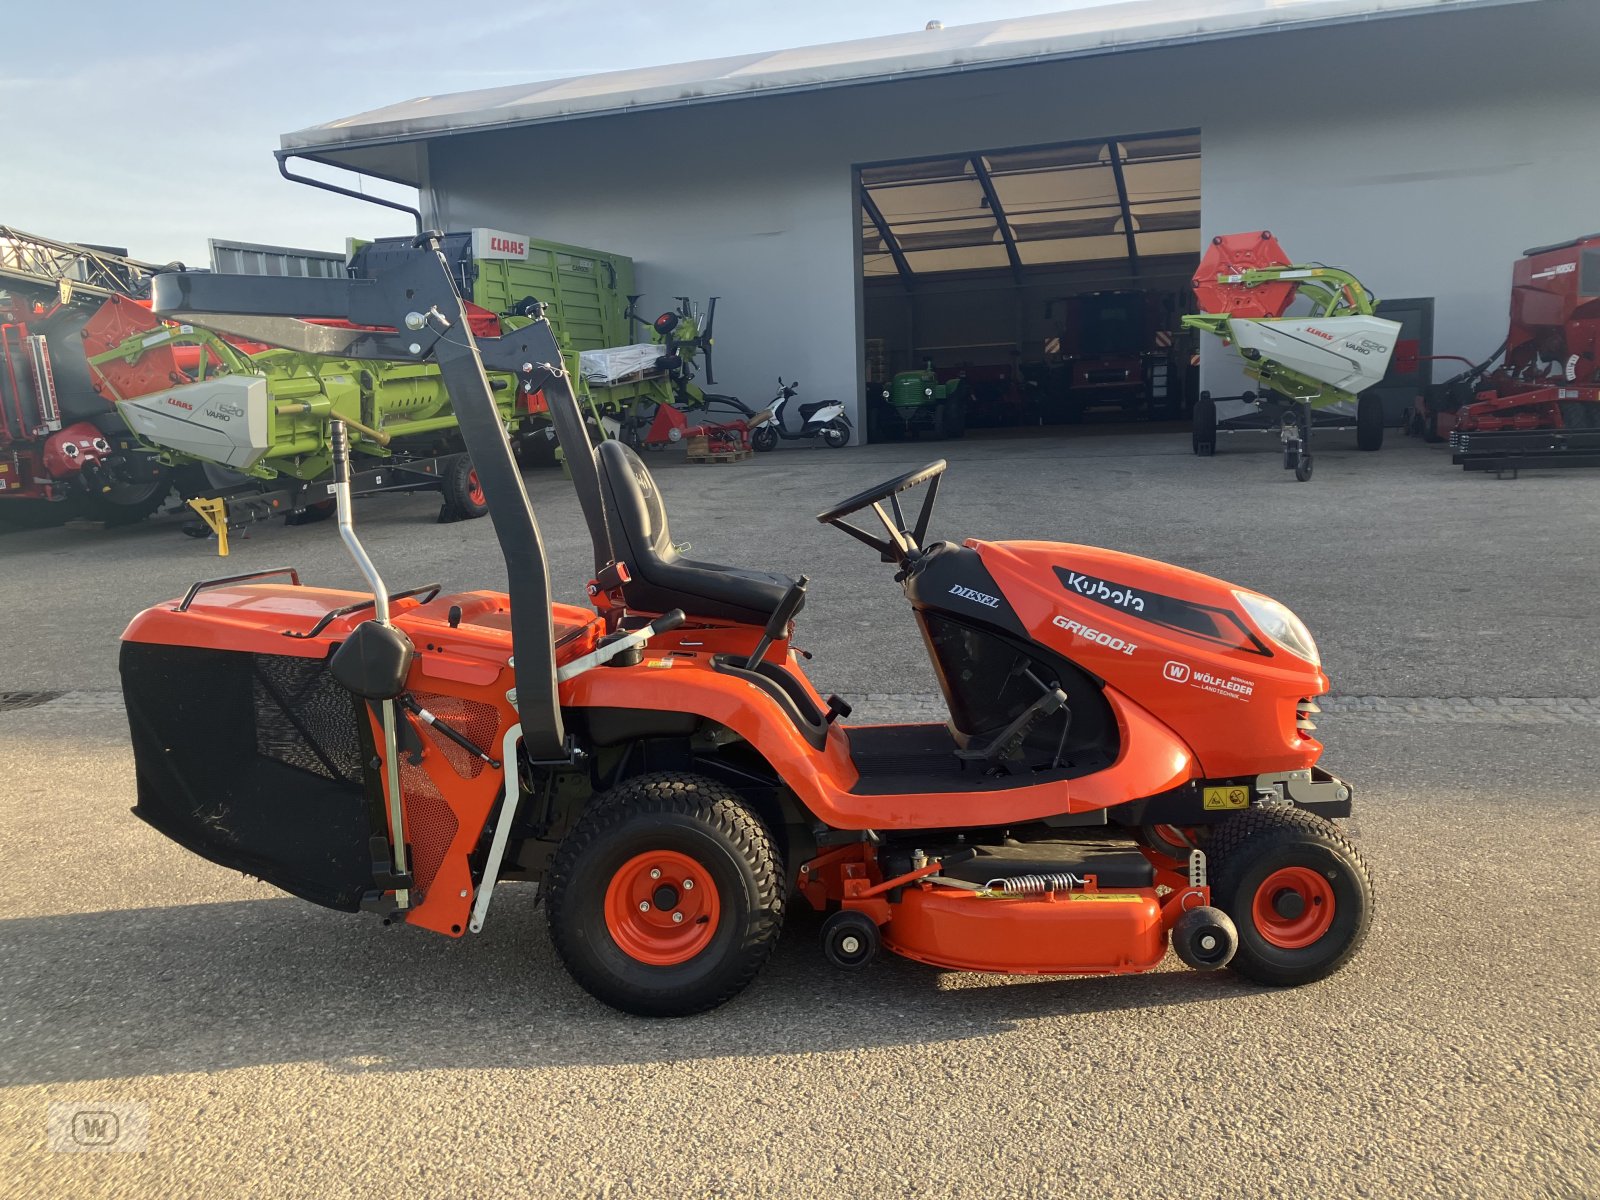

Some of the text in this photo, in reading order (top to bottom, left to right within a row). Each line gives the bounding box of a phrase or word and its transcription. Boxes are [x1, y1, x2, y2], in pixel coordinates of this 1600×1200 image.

[490, 237, 524, 255] CLAAS
[1305, 326, 1334, 341] CLAAS
[1345, 341, 1371, 356] VARIO
[168, 397, 193, 411] CLAAS
[205, 408, 231, 422] VARIO
[948, 584, 1001, 609] DIESEL
[1068, 572, 1145, 612] Kubota
[1193, 671, 1253, 696] WÖLFLEDER
[1201, 684, 1240, 700] LANDTECHNIK
